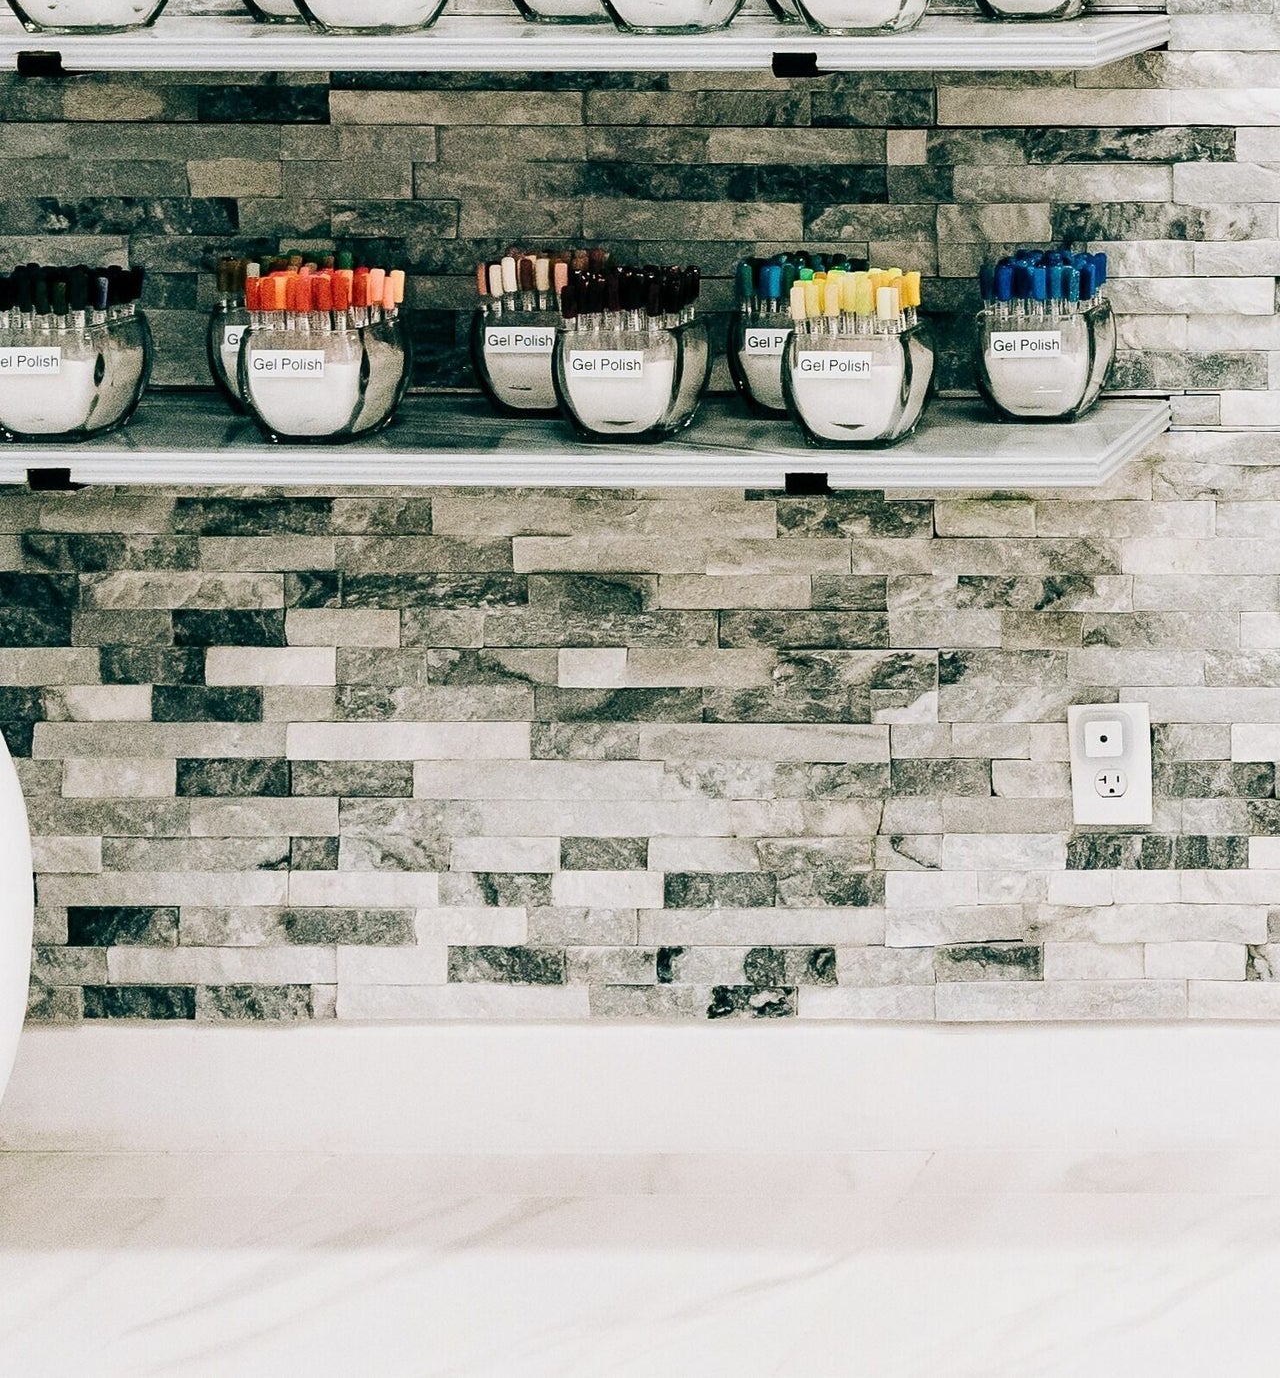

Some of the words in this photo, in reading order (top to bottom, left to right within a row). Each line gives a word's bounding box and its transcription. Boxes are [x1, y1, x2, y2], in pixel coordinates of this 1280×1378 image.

[487, 334, 511, 347] Gel
[514, 334, 554, 347] Polish
[747, 335, 771, 349] Gel
[992, 338, 1017, 352] Gel
[1020, 338, 1060, 352] Polish
[0, 354, 13, 368] el
[16, 354, 60, 368] Polish
[252, 357, 278, 371] Gel
[281, 357, 323, 372] Polish
[572, 357, 597, 371] Gel
[600, 357, 642, 372] Polish
[799, 358, 825, 373] Gel
[828, 358, 870, 373] Polish
